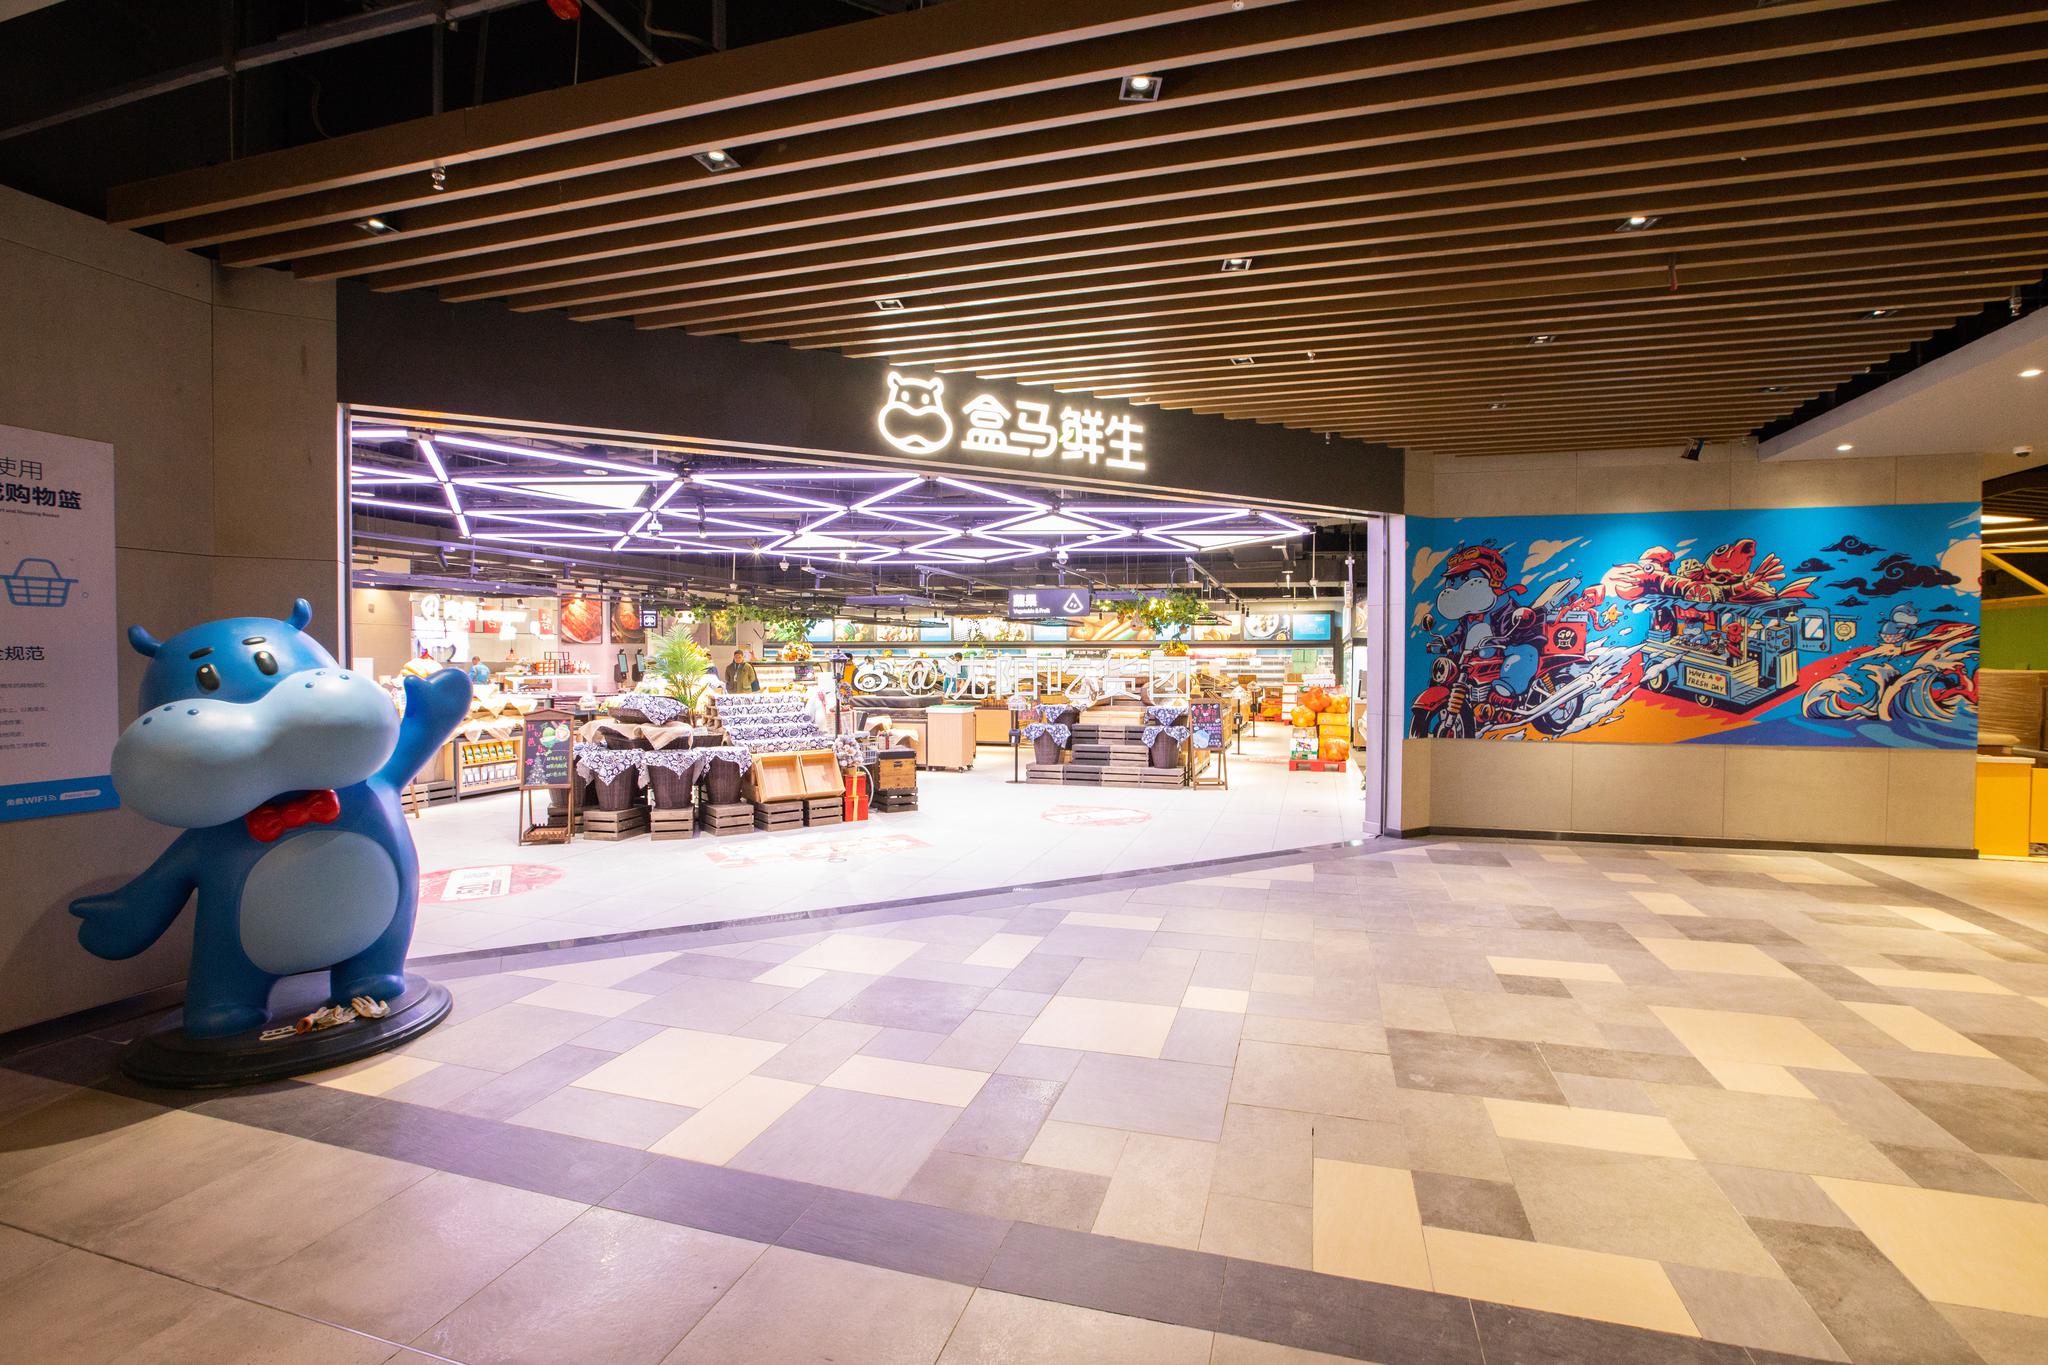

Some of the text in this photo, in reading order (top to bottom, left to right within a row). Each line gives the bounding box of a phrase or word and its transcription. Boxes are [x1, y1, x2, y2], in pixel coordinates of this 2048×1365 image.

[960, 393, 1146, 471] 盒马鲜生
[0, 482, 82, 510] 购物篮
[0, 645, 45, 661] 规范
[1689, 669, 1706, 679] HAVE
[1688, 677, 1725, 692] FRESH DAY
